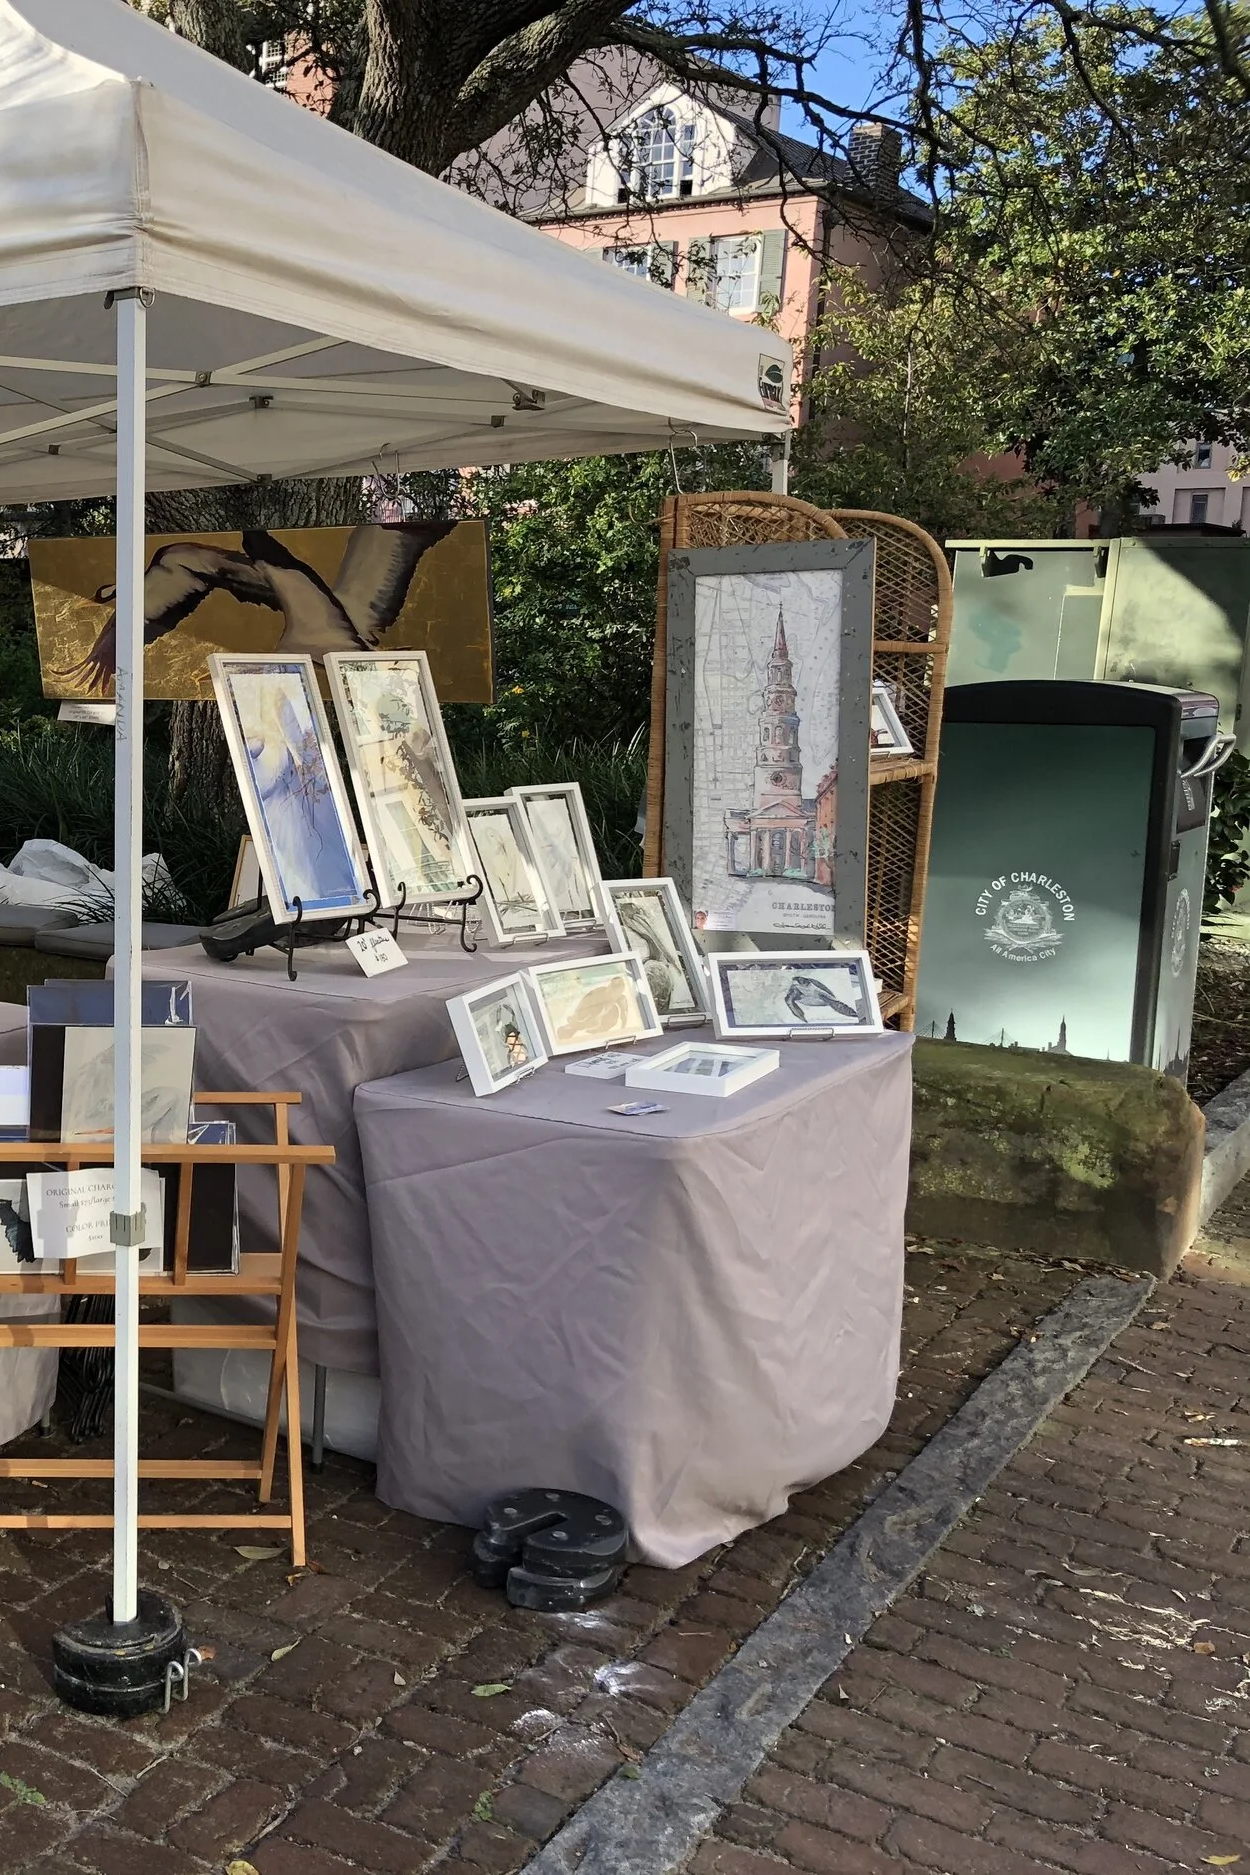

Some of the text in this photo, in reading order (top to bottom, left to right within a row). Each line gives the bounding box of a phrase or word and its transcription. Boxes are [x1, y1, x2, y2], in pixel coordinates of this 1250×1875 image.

[975, 871, 1076, 921] CITY OF CHARLESTON
[989, 943, 1056, 962] All America City
[46, 1186, 85, 1197] ORIGINAL
[59, 1199, 79, 1209] Small
[65, 1219, 110, 1233] COLOR PRI
